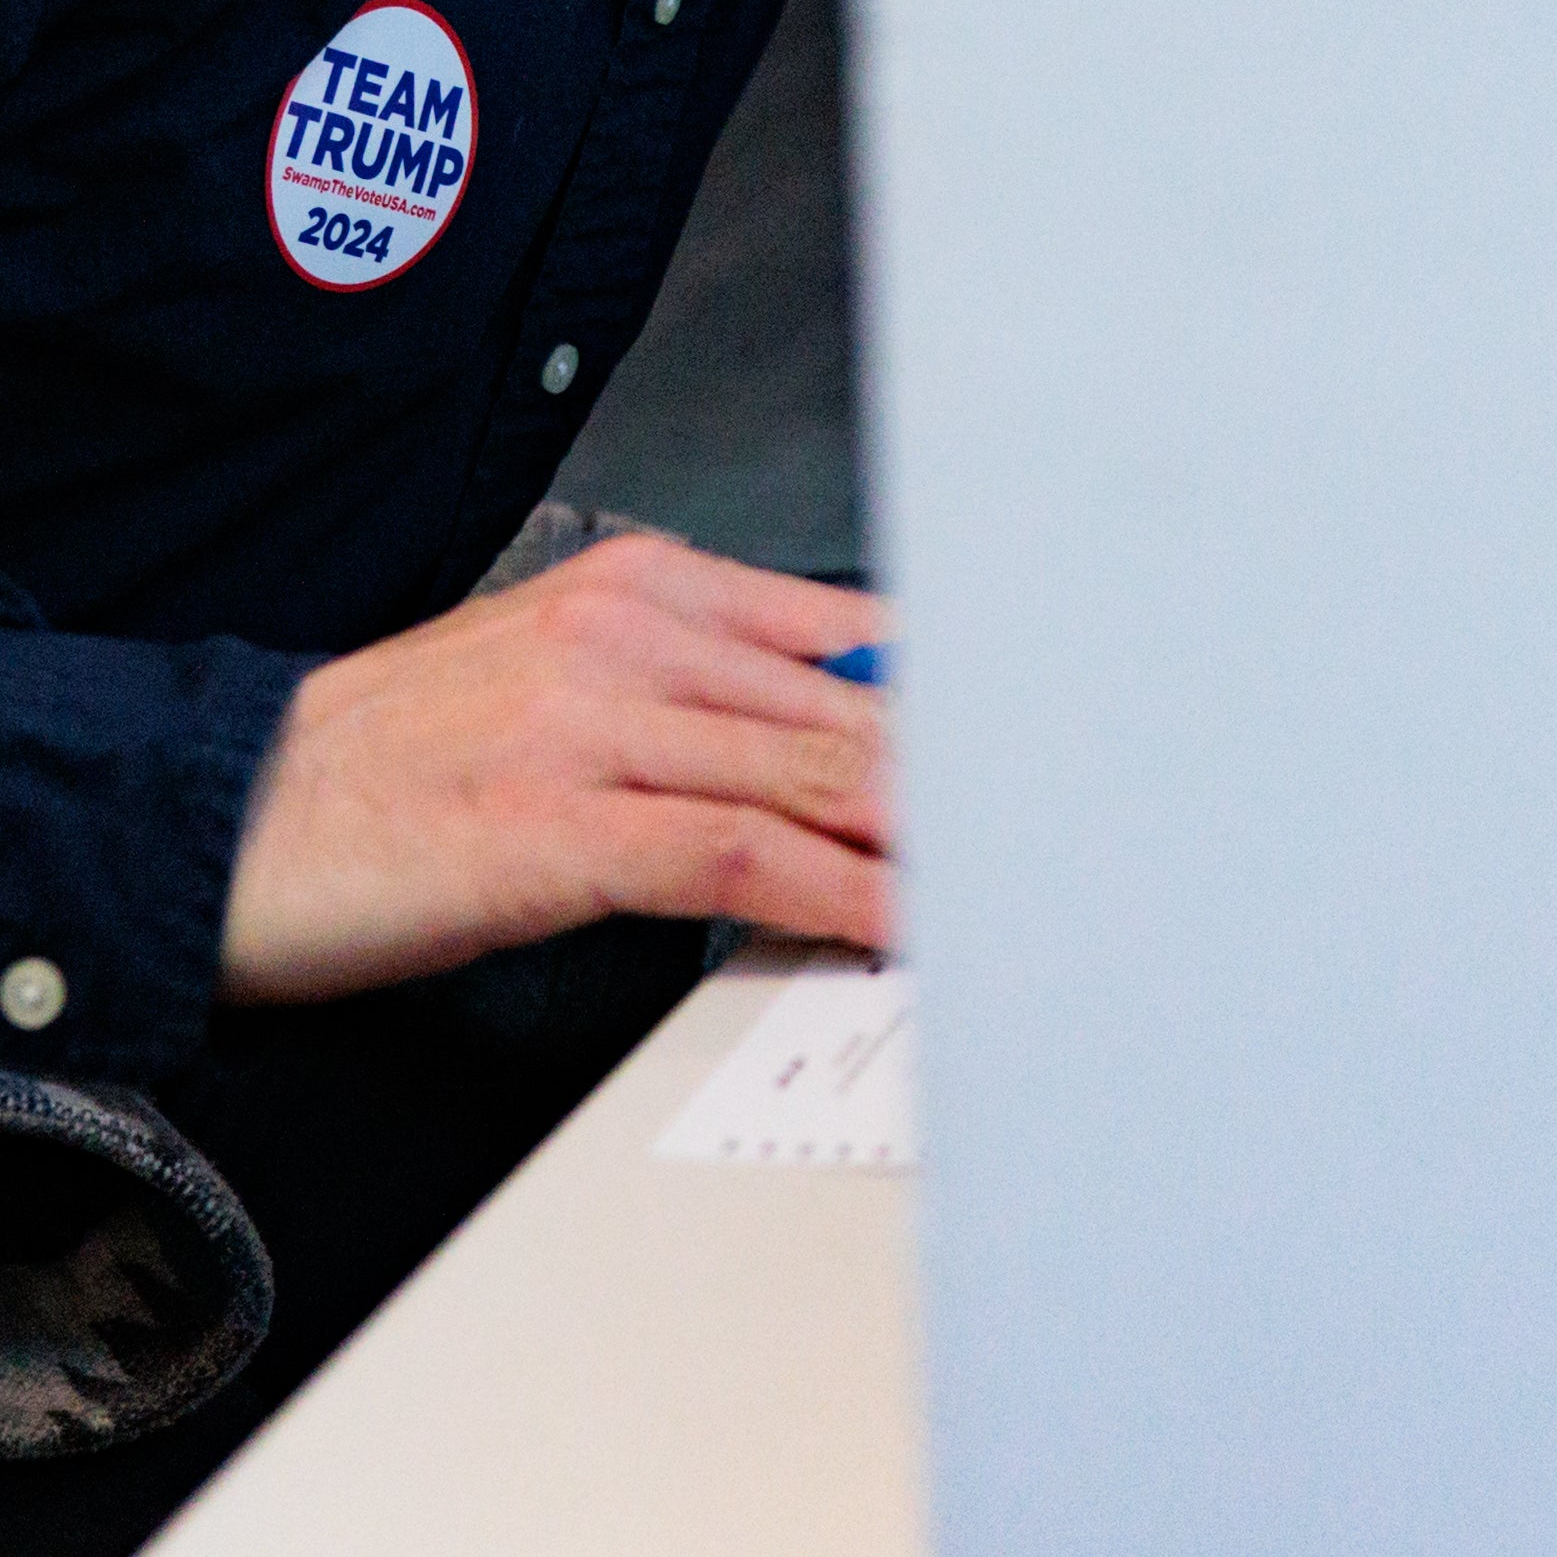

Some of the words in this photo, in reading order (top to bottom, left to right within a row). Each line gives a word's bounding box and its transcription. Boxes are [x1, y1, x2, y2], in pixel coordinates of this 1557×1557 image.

[323, 46, 463, 140] TEAM
[286, 101, 464, 198] TRUMP
[282, 166, 436, 221] SwampTheVoteUSA.com
[298, 206, 394, 263] 2024
